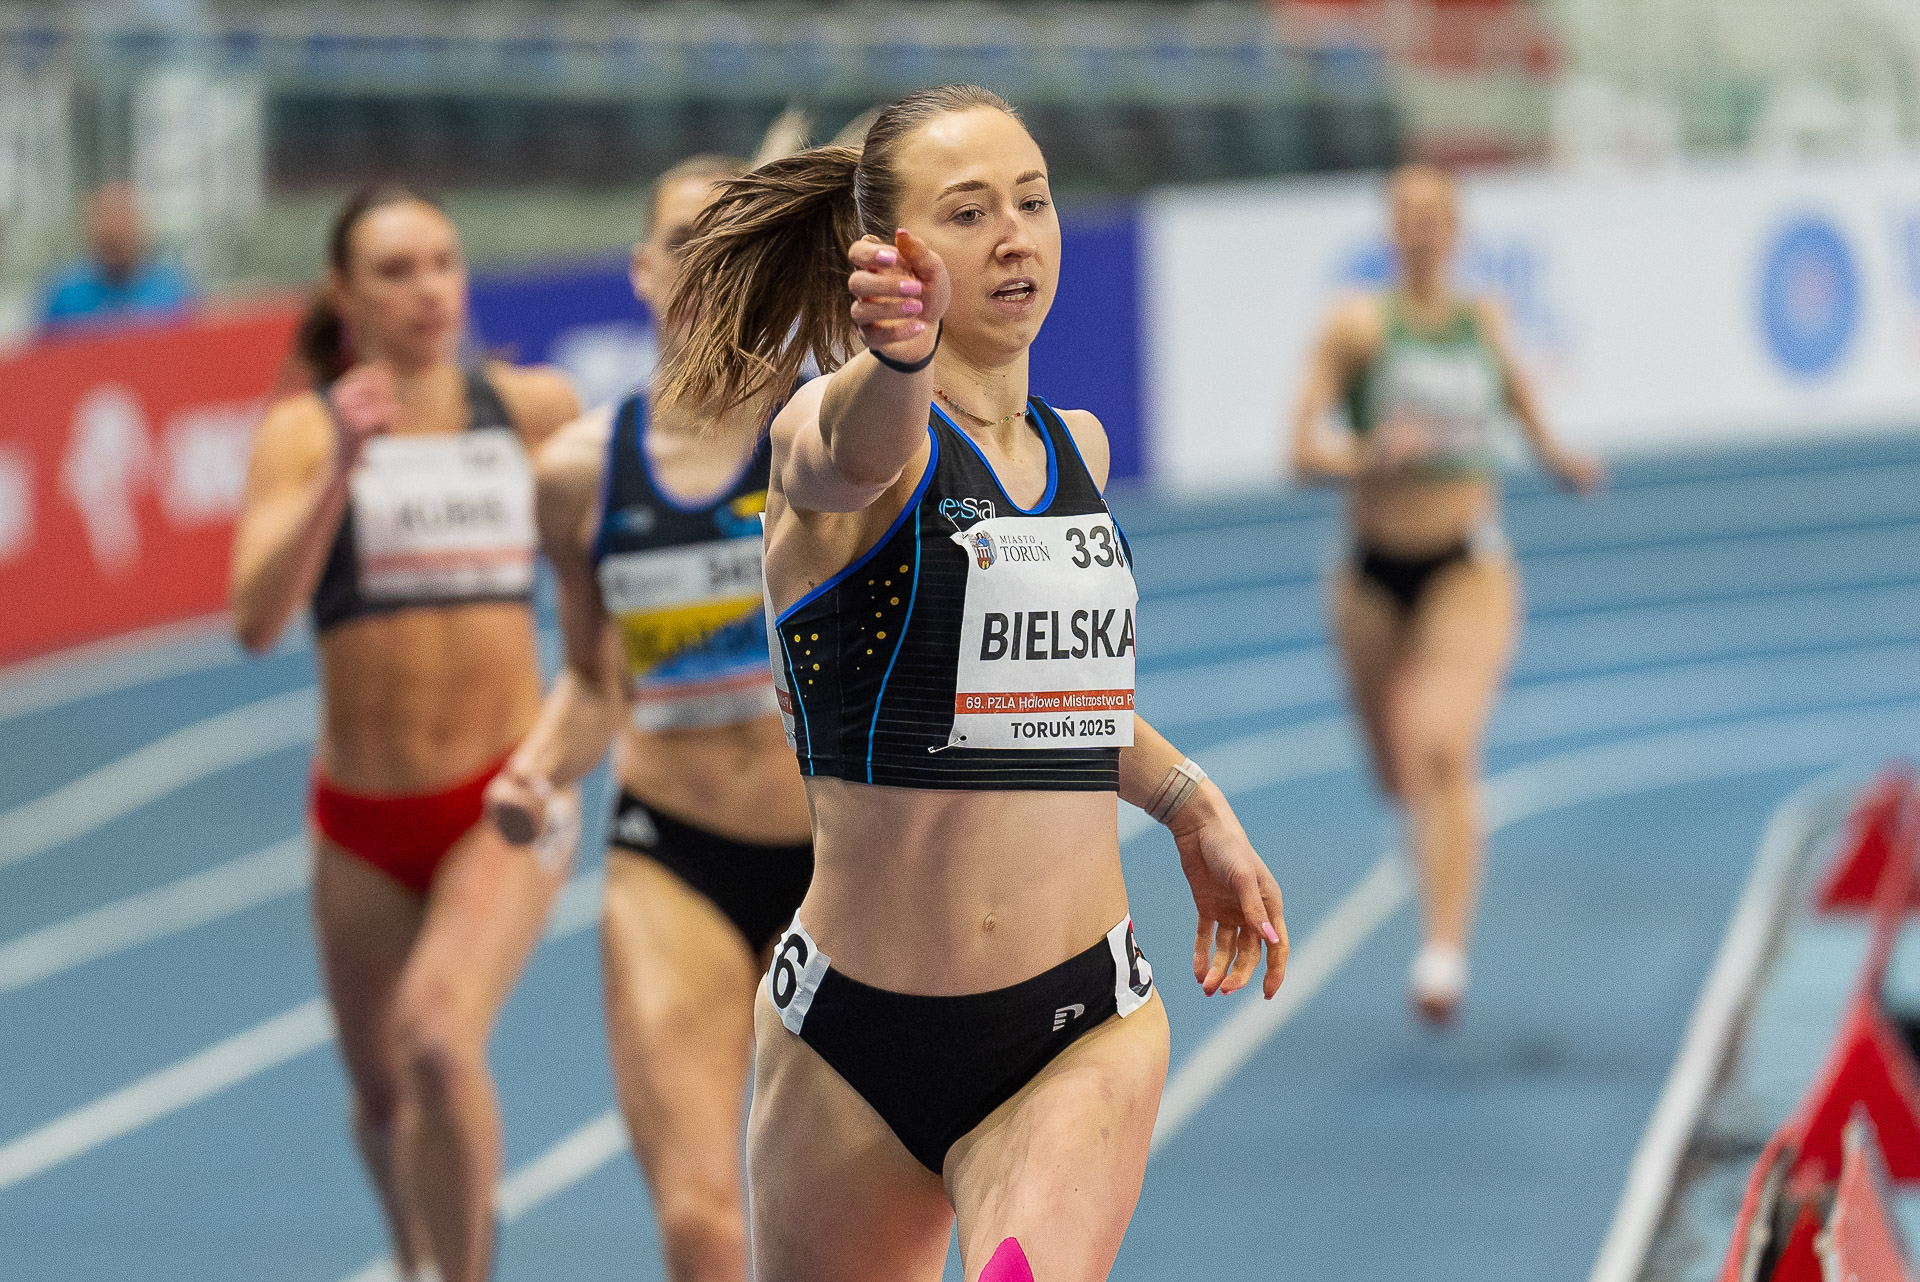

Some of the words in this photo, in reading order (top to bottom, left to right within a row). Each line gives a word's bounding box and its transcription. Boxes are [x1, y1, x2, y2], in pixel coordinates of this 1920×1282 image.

[1000, 535, 1036, 544] MIASTO
[1000, 541, 1051, 562] TORUŃ
[980, 608, 1136, 661] BIELSKA
[966, 697, 984, 709] 69.
[987, 696, 1014, 709] PZLA
[1019, 694, 1060, 709] Halowe
[1062, 694, 1124, 707] Mistrzostwa
[1011, 716, 1075, 738] TORUŃ
[1080, 719, 1116, 737] 2025
[773, 934, 808, 1010] 6
